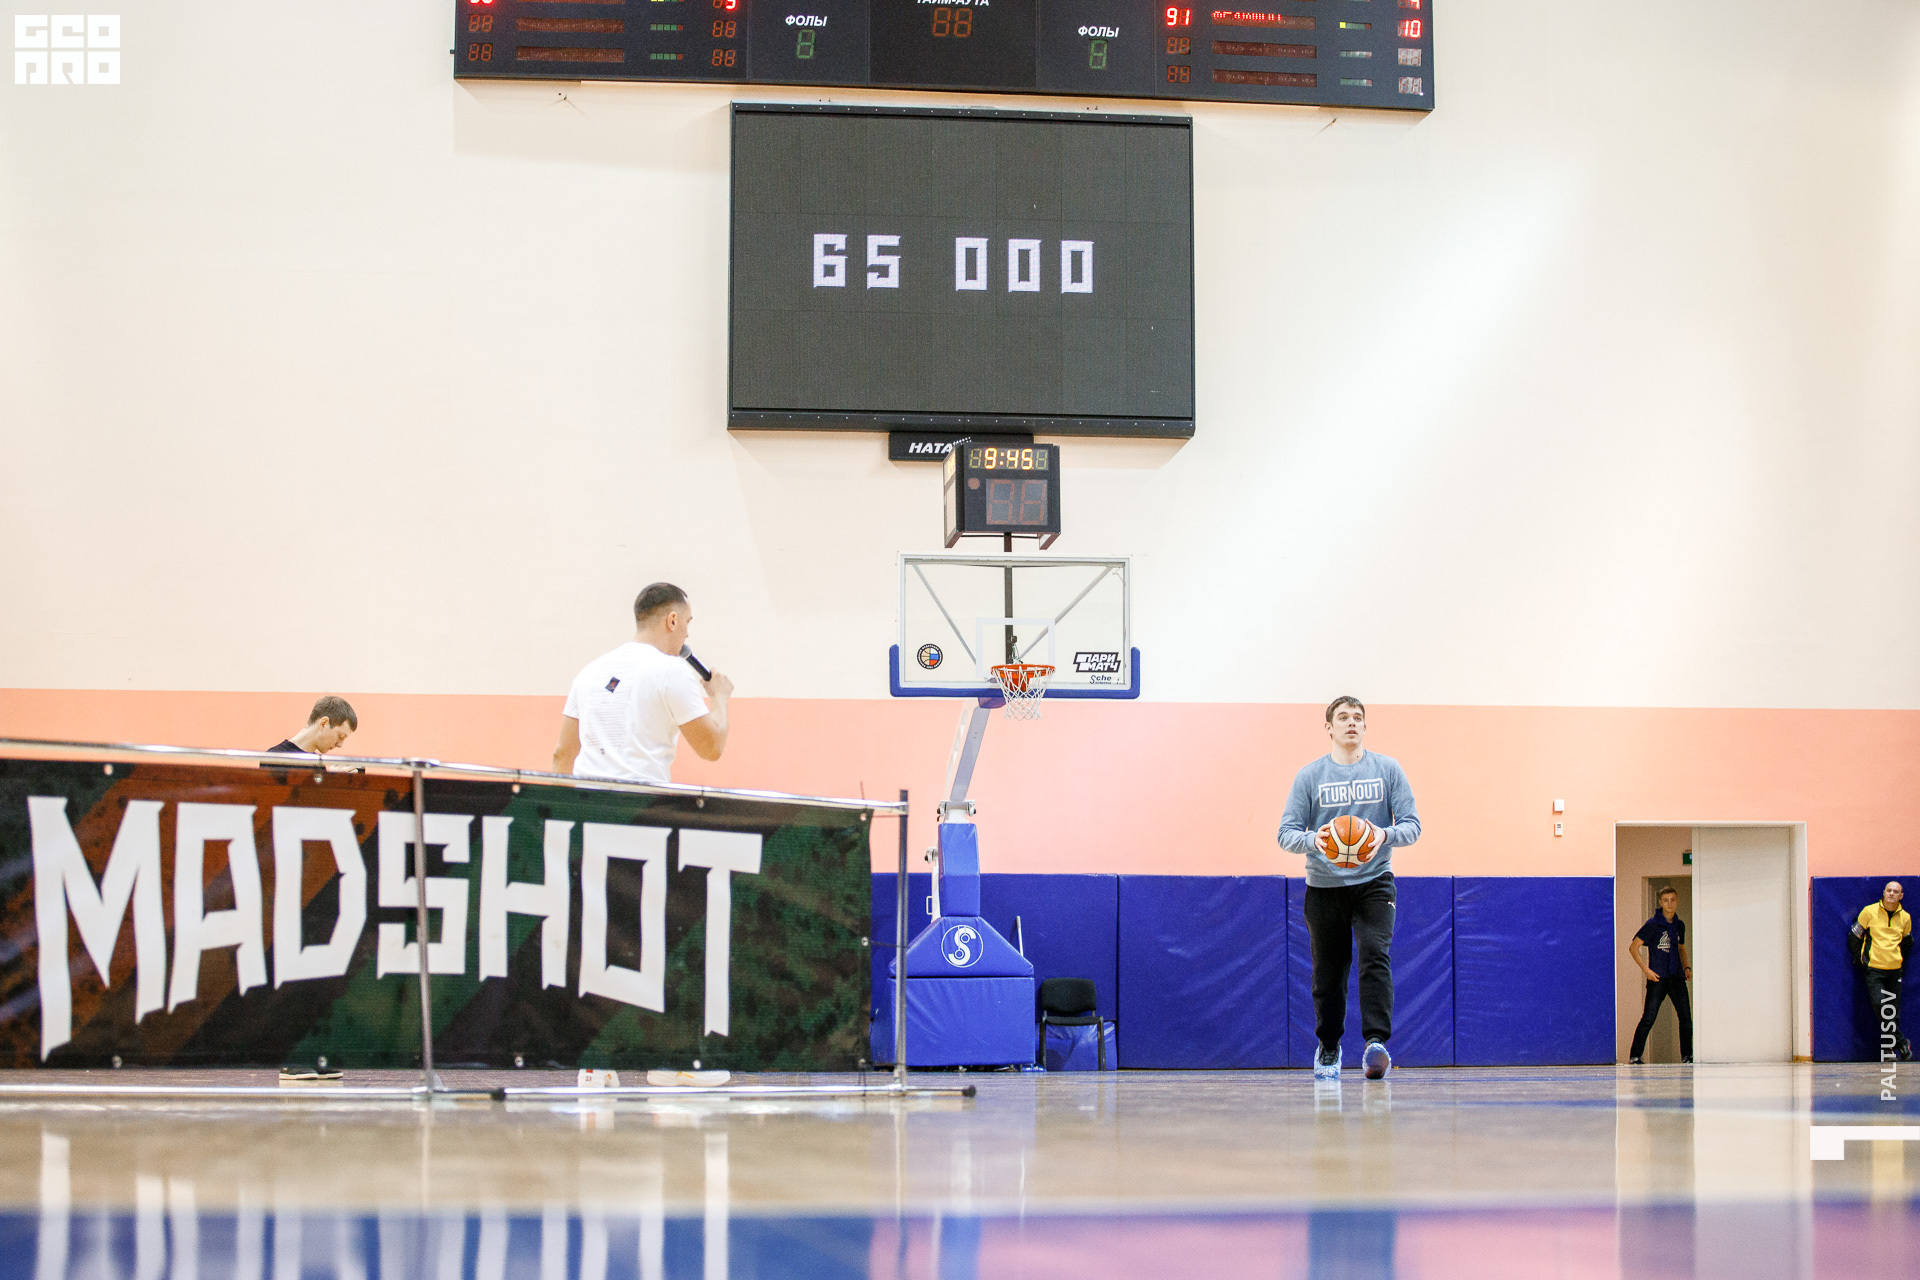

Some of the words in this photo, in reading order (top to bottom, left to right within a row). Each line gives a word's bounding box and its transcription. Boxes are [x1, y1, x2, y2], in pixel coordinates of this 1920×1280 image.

[785, 14, 828, 27] ФОЛЫ
[1166, 7, 1191, 26] 91
[1077, 25, 1120, 38] ФОЛЫ
[1403, 19, 1421, 38] 10
[813, 233, 902, 290] 65
[955, 237, 1094, 293] 000
[984, 447, 1033, 471] 9:45
[1075, 653, 1116, 662] ПАРИ
[1078, 662, 1118, 671] МАТЧ
[1322, 782, 1380, 804] TURNOUT
[28, 796, 762, 1062] MADSHOT
